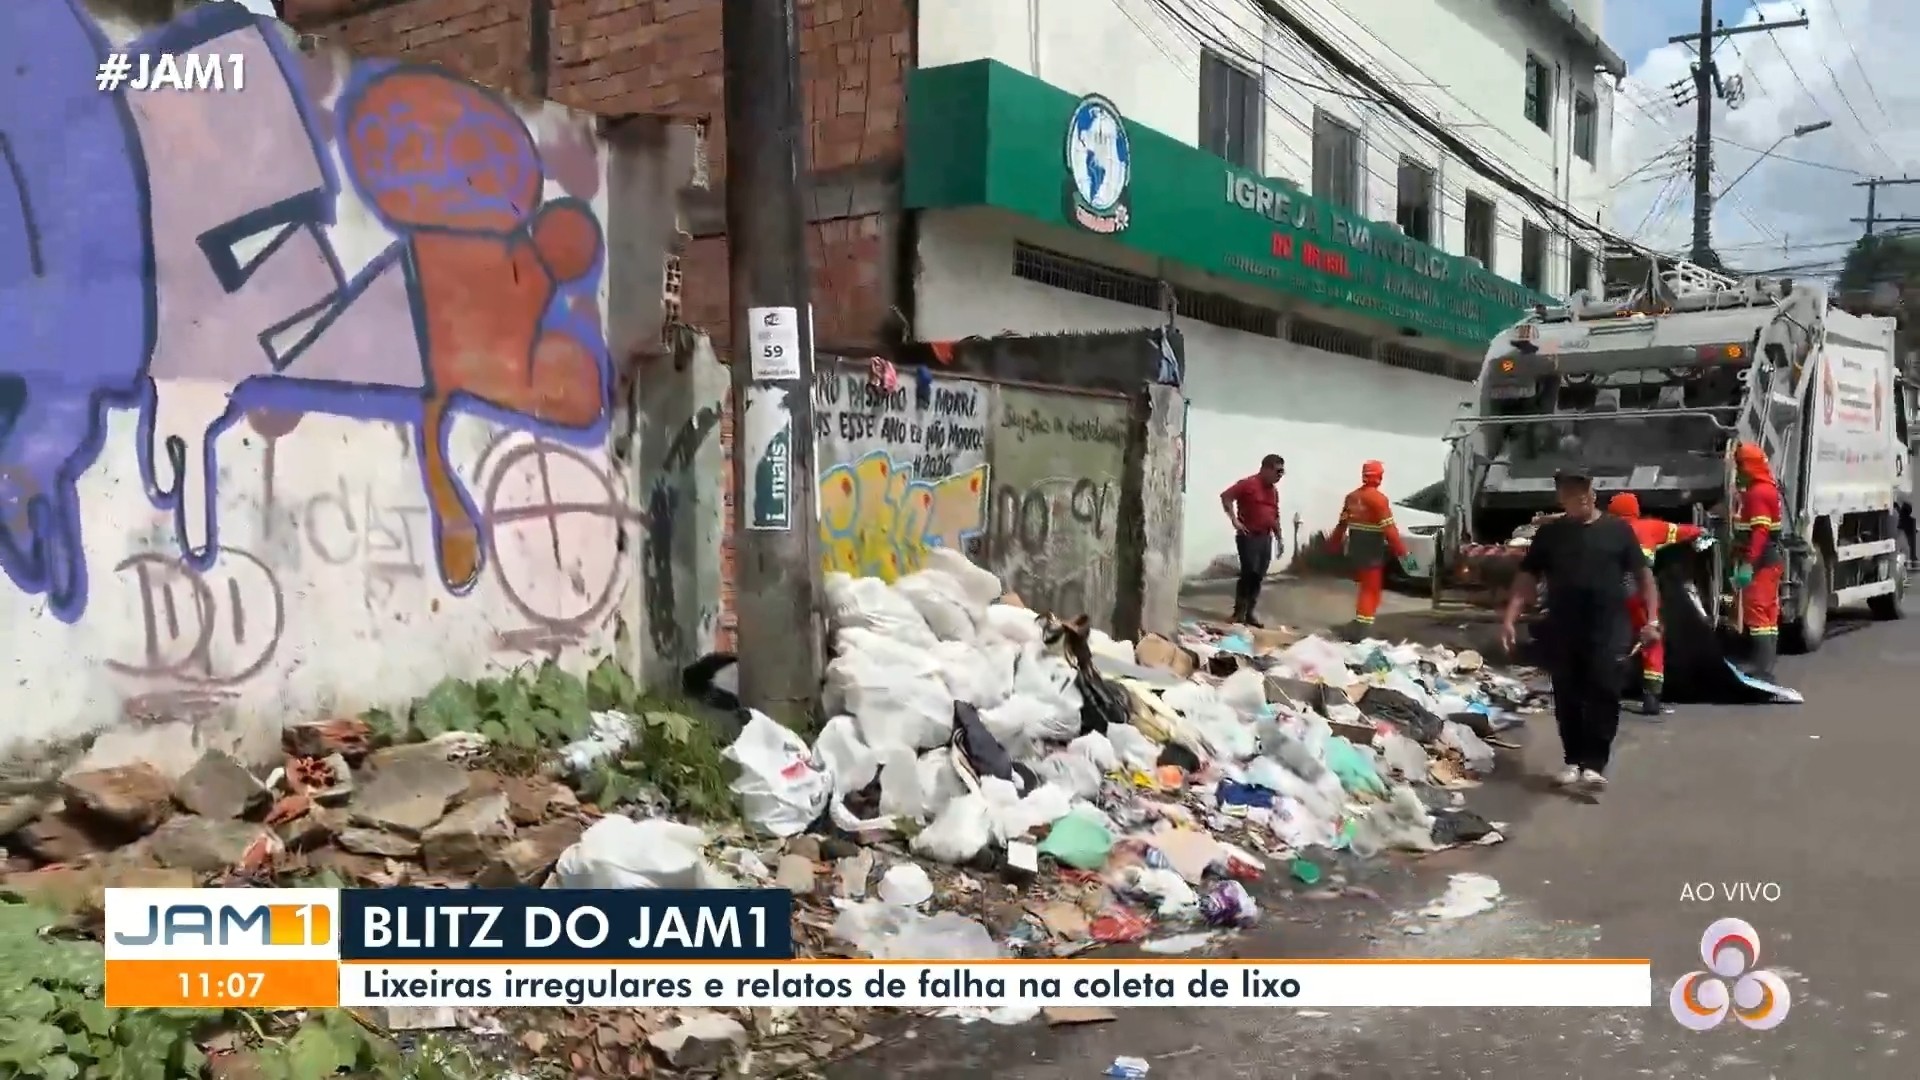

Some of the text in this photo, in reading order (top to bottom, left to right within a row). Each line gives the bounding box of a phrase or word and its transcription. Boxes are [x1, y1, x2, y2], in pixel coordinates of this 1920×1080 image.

[1226, 170, 1318, 235] IGREJA
[764, 345, 783, 358] 59
[840, 411, 877, 441] ESSE
[881, 417, 906, 443] ANO
